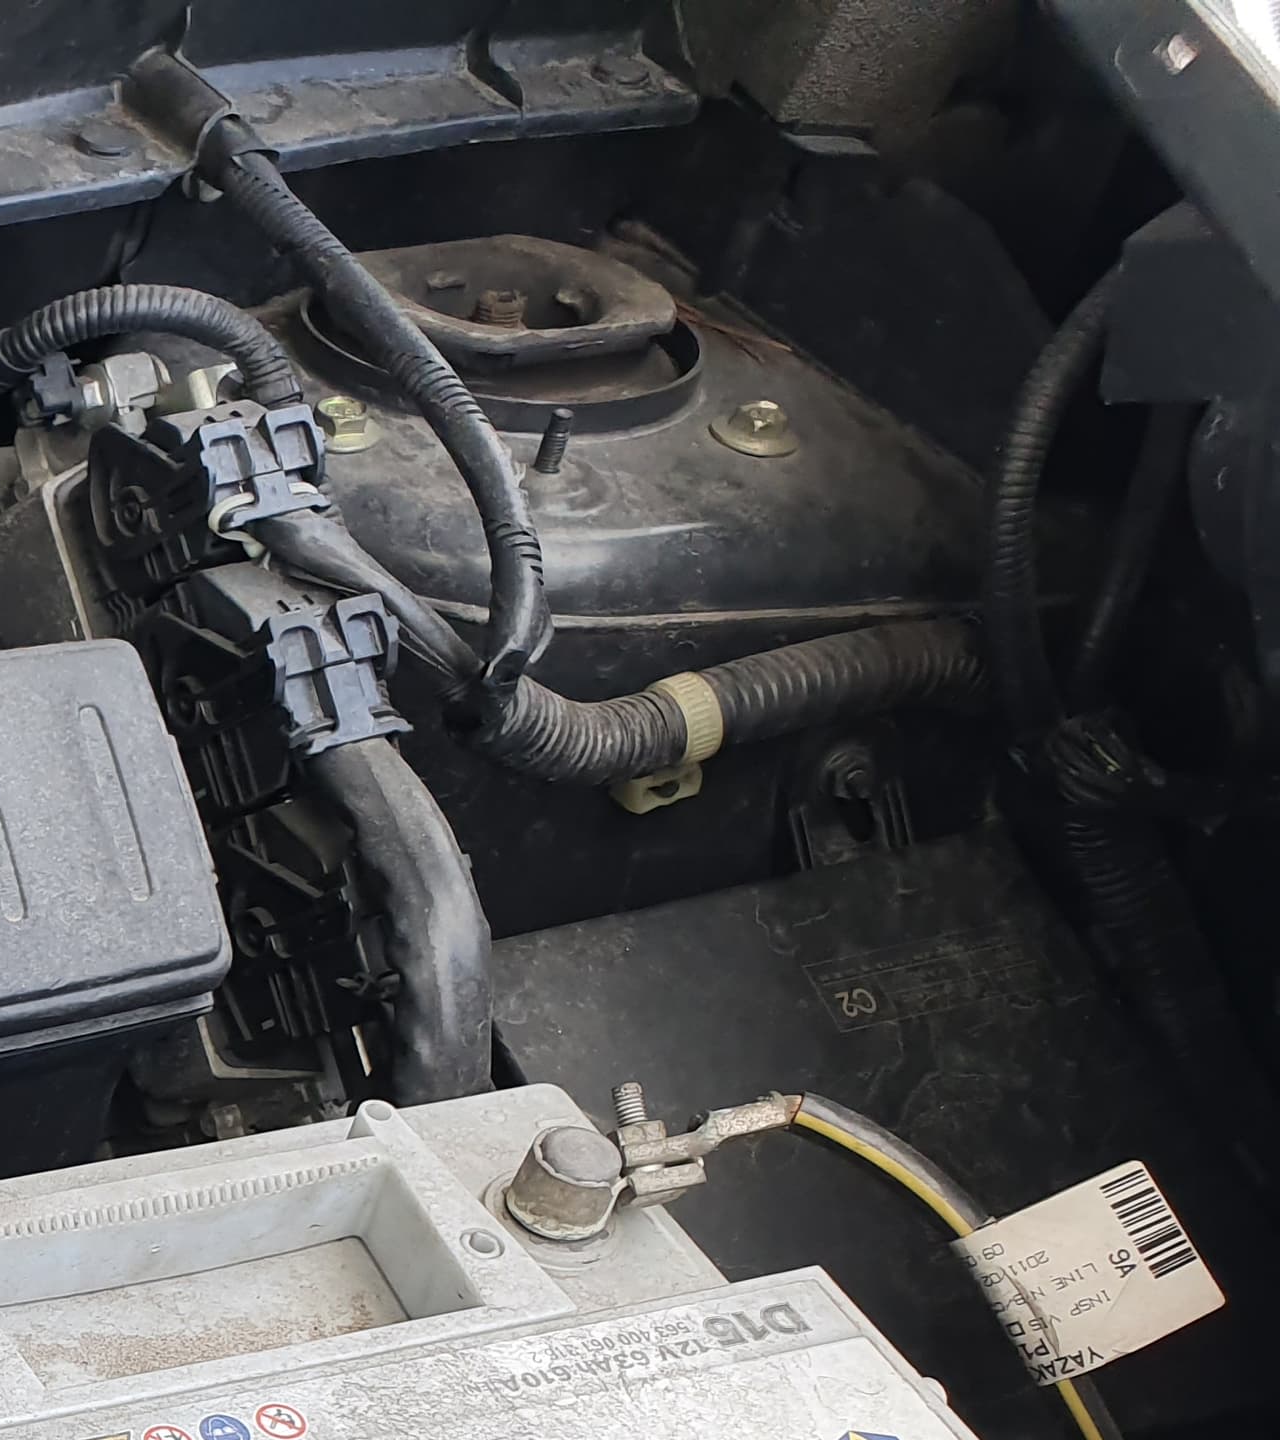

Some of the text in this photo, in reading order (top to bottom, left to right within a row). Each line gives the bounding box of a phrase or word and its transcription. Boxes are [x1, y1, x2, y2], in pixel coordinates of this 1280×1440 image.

[1051, 1262, 1099, 1291] LINE
[1069, 1289, 1112, 1317] INSP
[654, 1320, 690, 1340] 563
[702, 1301, 814, 1347] D15
[616, 1329, 651, 1348] 400
[659, 1338, 715, 1362] 12V
[576, 1350, 651, 1376] 63Ah
